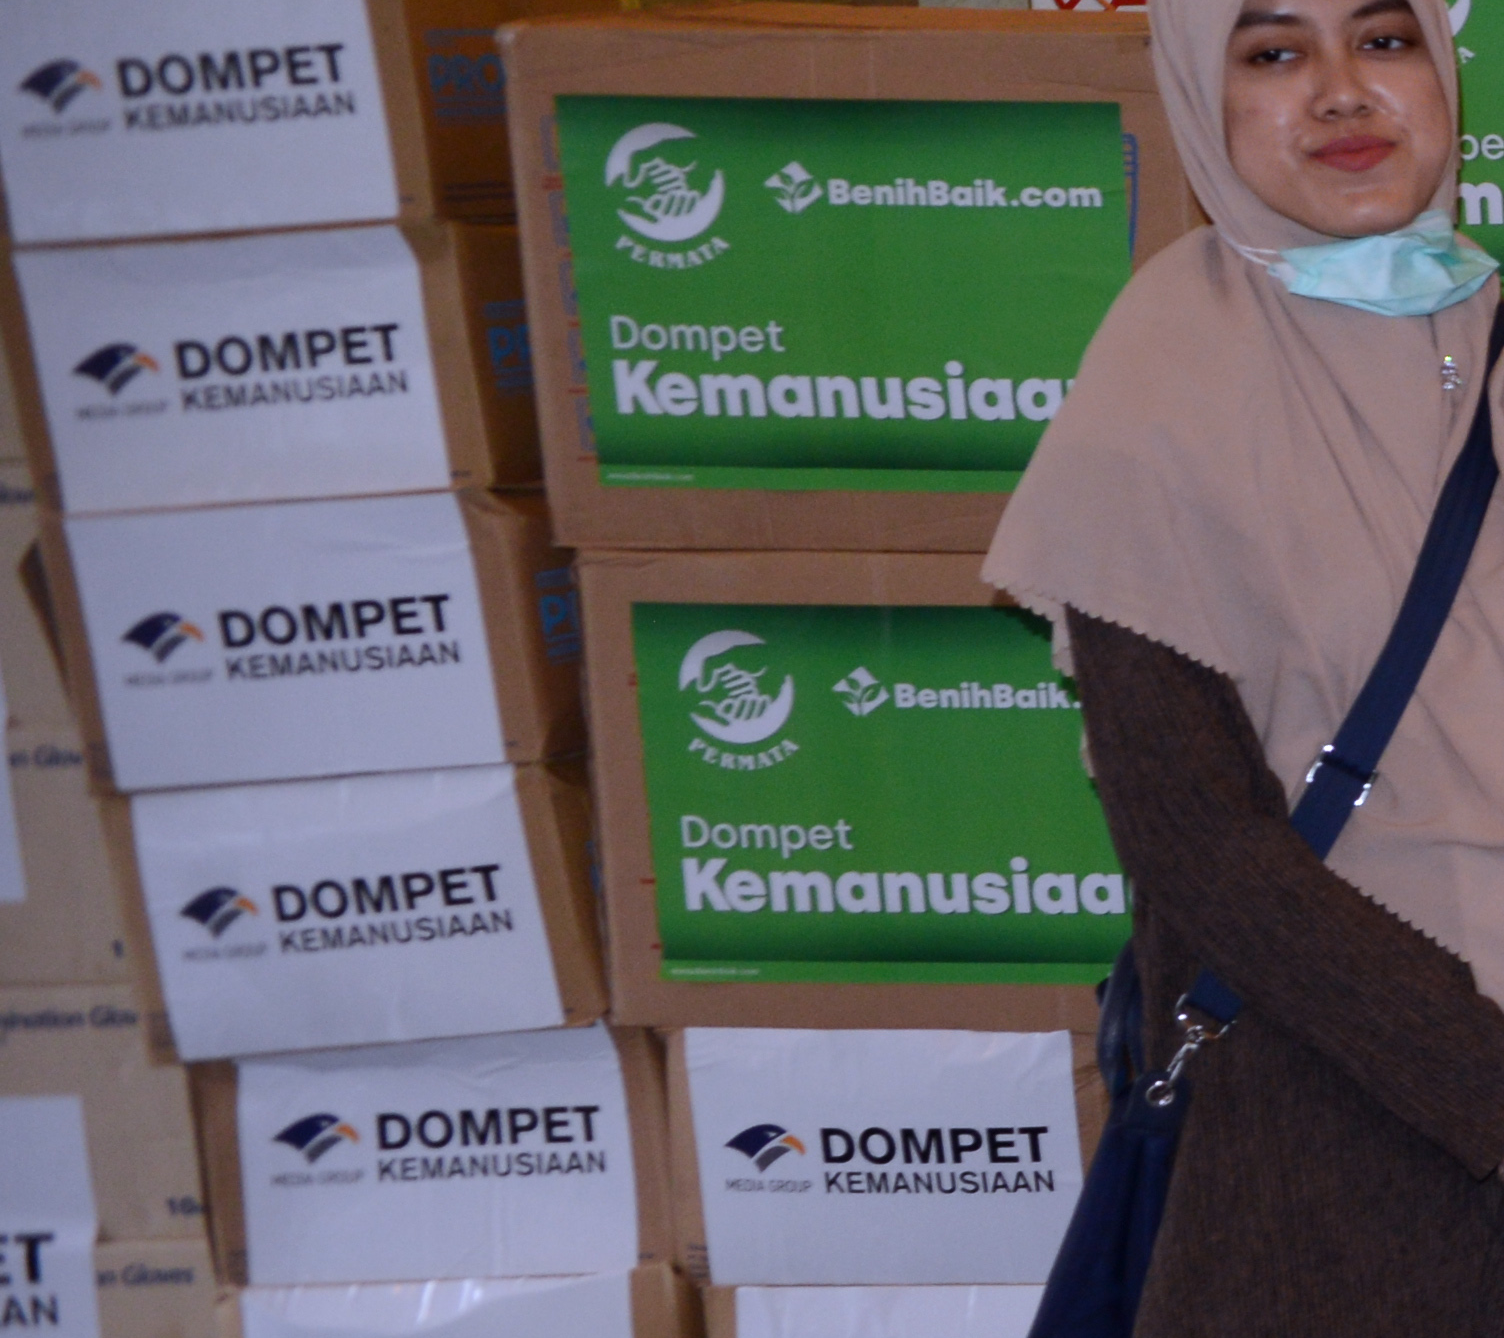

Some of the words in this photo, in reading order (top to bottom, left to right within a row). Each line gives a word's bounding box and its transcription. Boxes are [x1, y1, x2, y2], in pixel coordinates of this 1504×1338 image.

[115, 44, 342, 99] DOMPET
[122, 94, 354, 131] KEMANUSIAAN
[828, 178, 1102, 207] BenihBaik.com
[613, 235, 730, 269] PERMATA
[173, 322, 400, 378] DOMPET
[611, 315, 785, 361] Dompet
[181, 374, 407, 411] KEMANUSIAAN
[614, 360, 1073, 421] Kemanusiaa
[218, 595, 452, 647] DOMPET
[225, 643, 460, 680] KEMANUSIAAN
[688, 737, 798, 770] PERMATA
[681, 815, 853, 858] Dompet
[272, 864, 500, 920] DOMPET
[280, 911, 513, 952] KEMANUSIAAN
[376, 1106, 599, 1150] DOMPET
[821, 1127, 1048, 1164] DOMPET
[378, 1151, 606, 1181] KEMANUSIAAN
[825, 1171, 1054, 1194] KEMANUSIAAN
